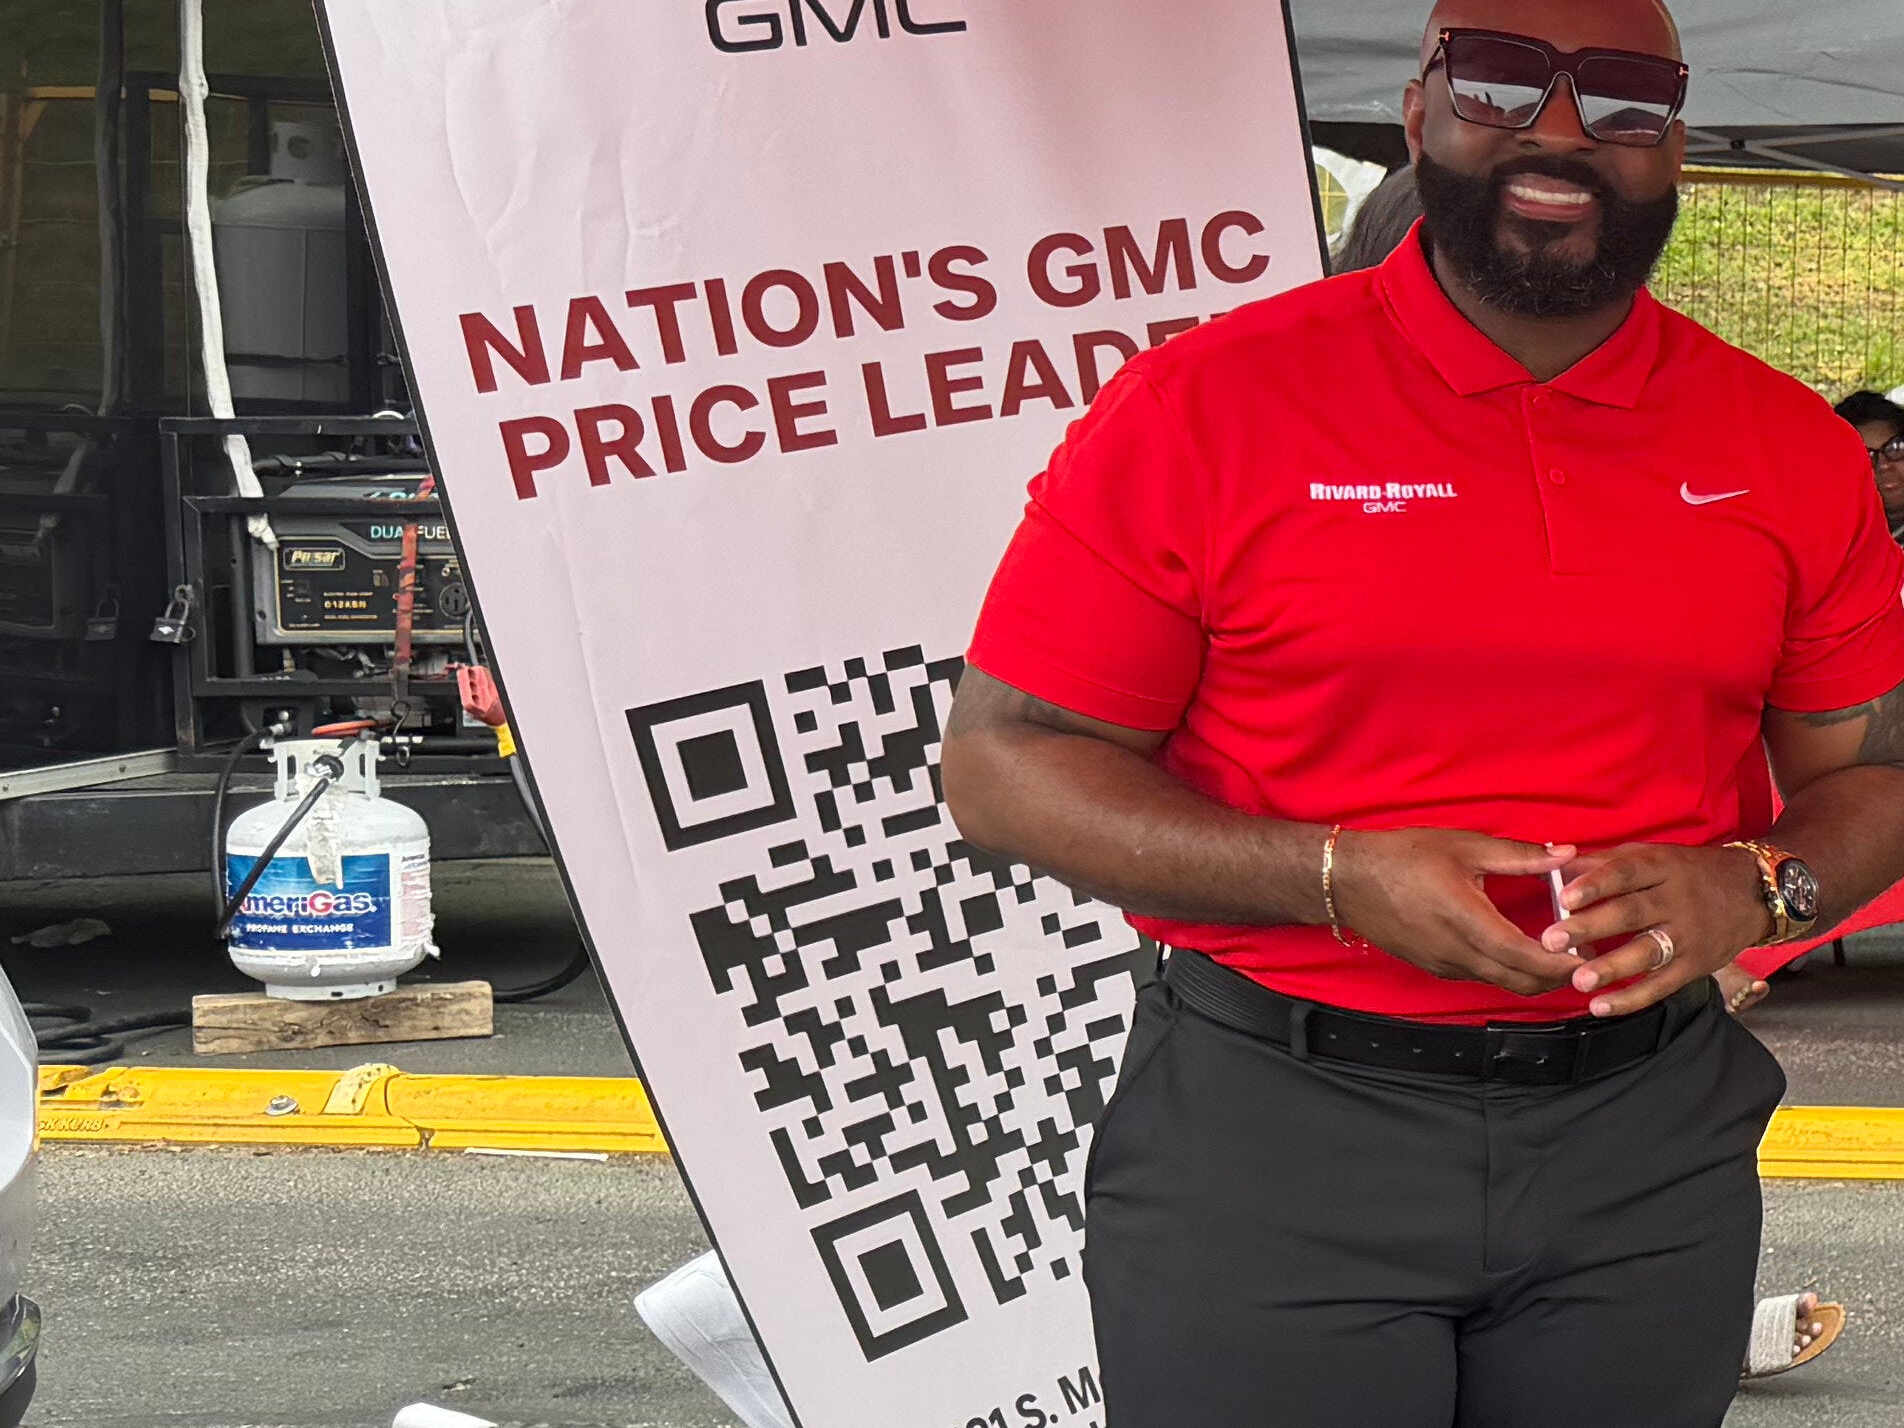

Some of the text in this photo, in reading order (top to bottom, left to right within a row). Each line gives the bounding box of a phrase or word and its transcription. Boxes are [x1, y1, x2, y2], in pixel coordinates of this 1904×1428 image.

[458, 209, 1272, 395] NATION'S GMC
[497, 311, 1232, 500] PRICE LEAD
[1309, 482, 1459, 501] RIVARD-ROYALL
[1362, 500, 1407, 514] GMC
[370, 525, 404, 538] DUA
[239, 890, 374, 916] meriGas
[291, 922, 354, 935] EXCHANGE
